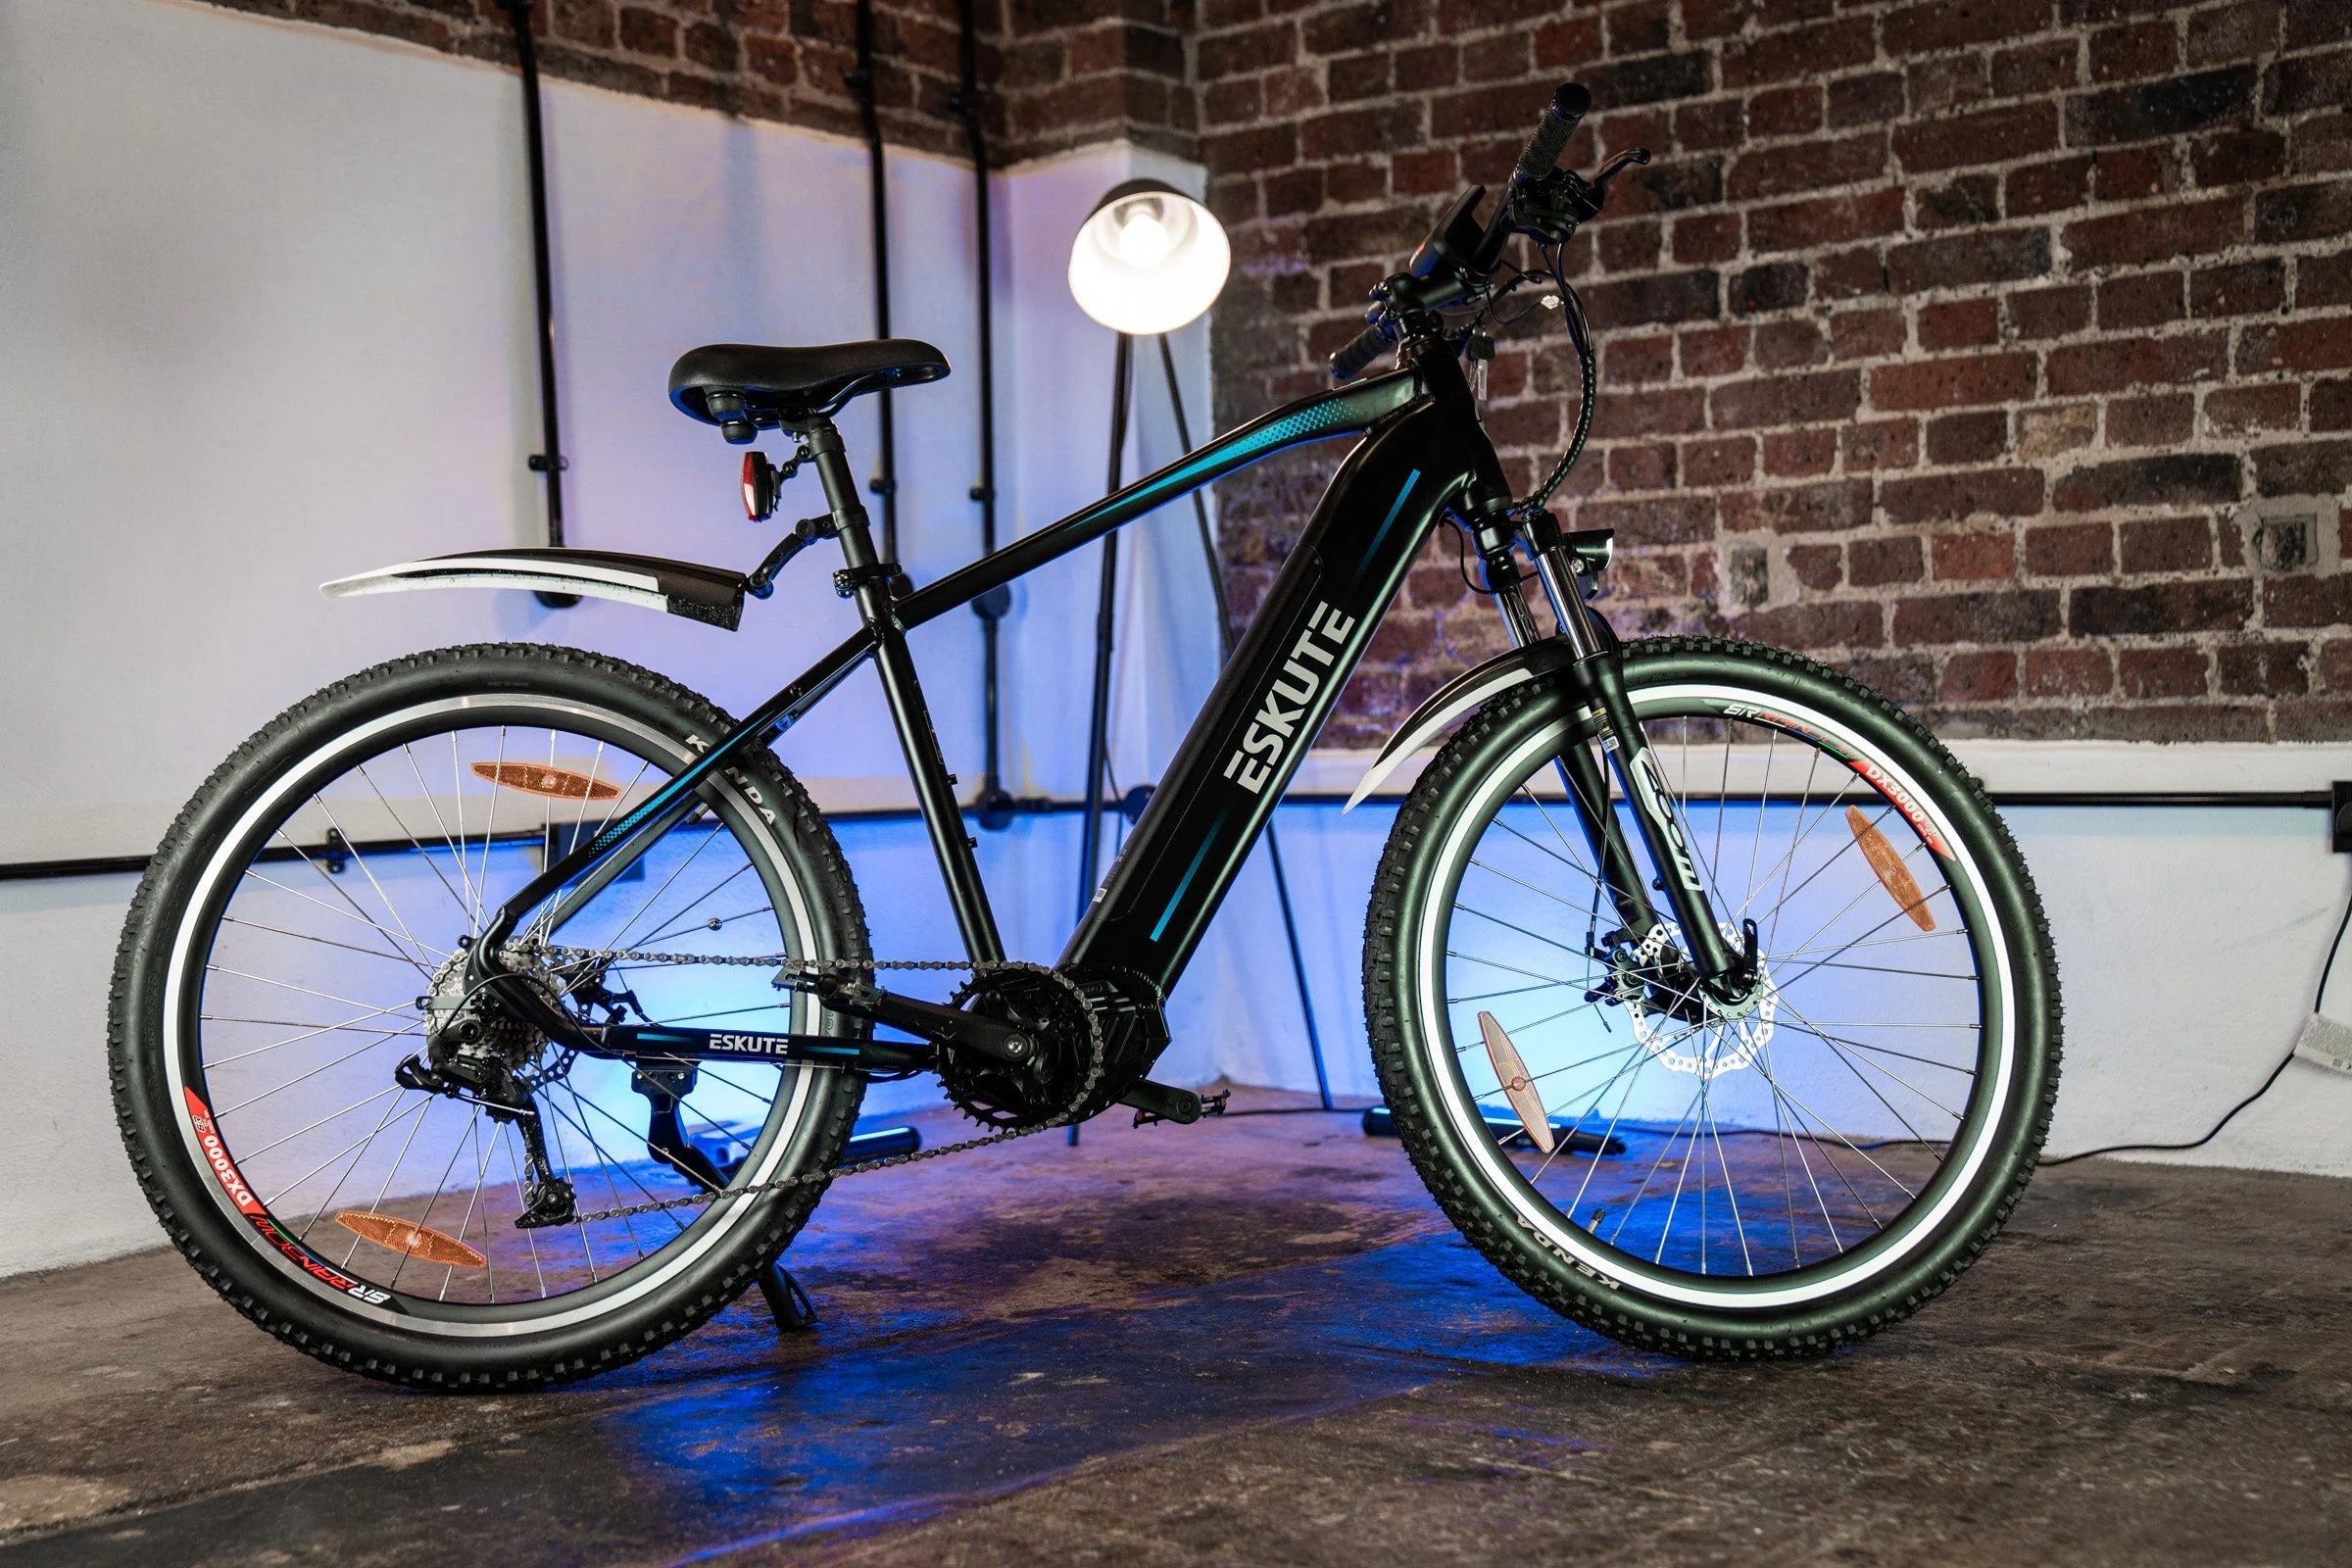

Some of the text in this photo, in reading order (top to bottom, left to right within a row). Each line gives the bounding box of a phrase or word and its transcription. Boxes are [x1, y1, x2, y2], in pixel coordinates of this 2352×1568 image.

[1223, 601, 1355, 794] ESKUTE
[685, 734, 776, 824] KNDA
[1866, 765, 1925, 822] DX3000
[709, 1033, 789, 1054] ESKUTE
[204, 1135, 254, 1206] DX3000
[250, 1215, 354, 1291] RAINBOW
[1518, 1214, 1620, 1290] KENDA
